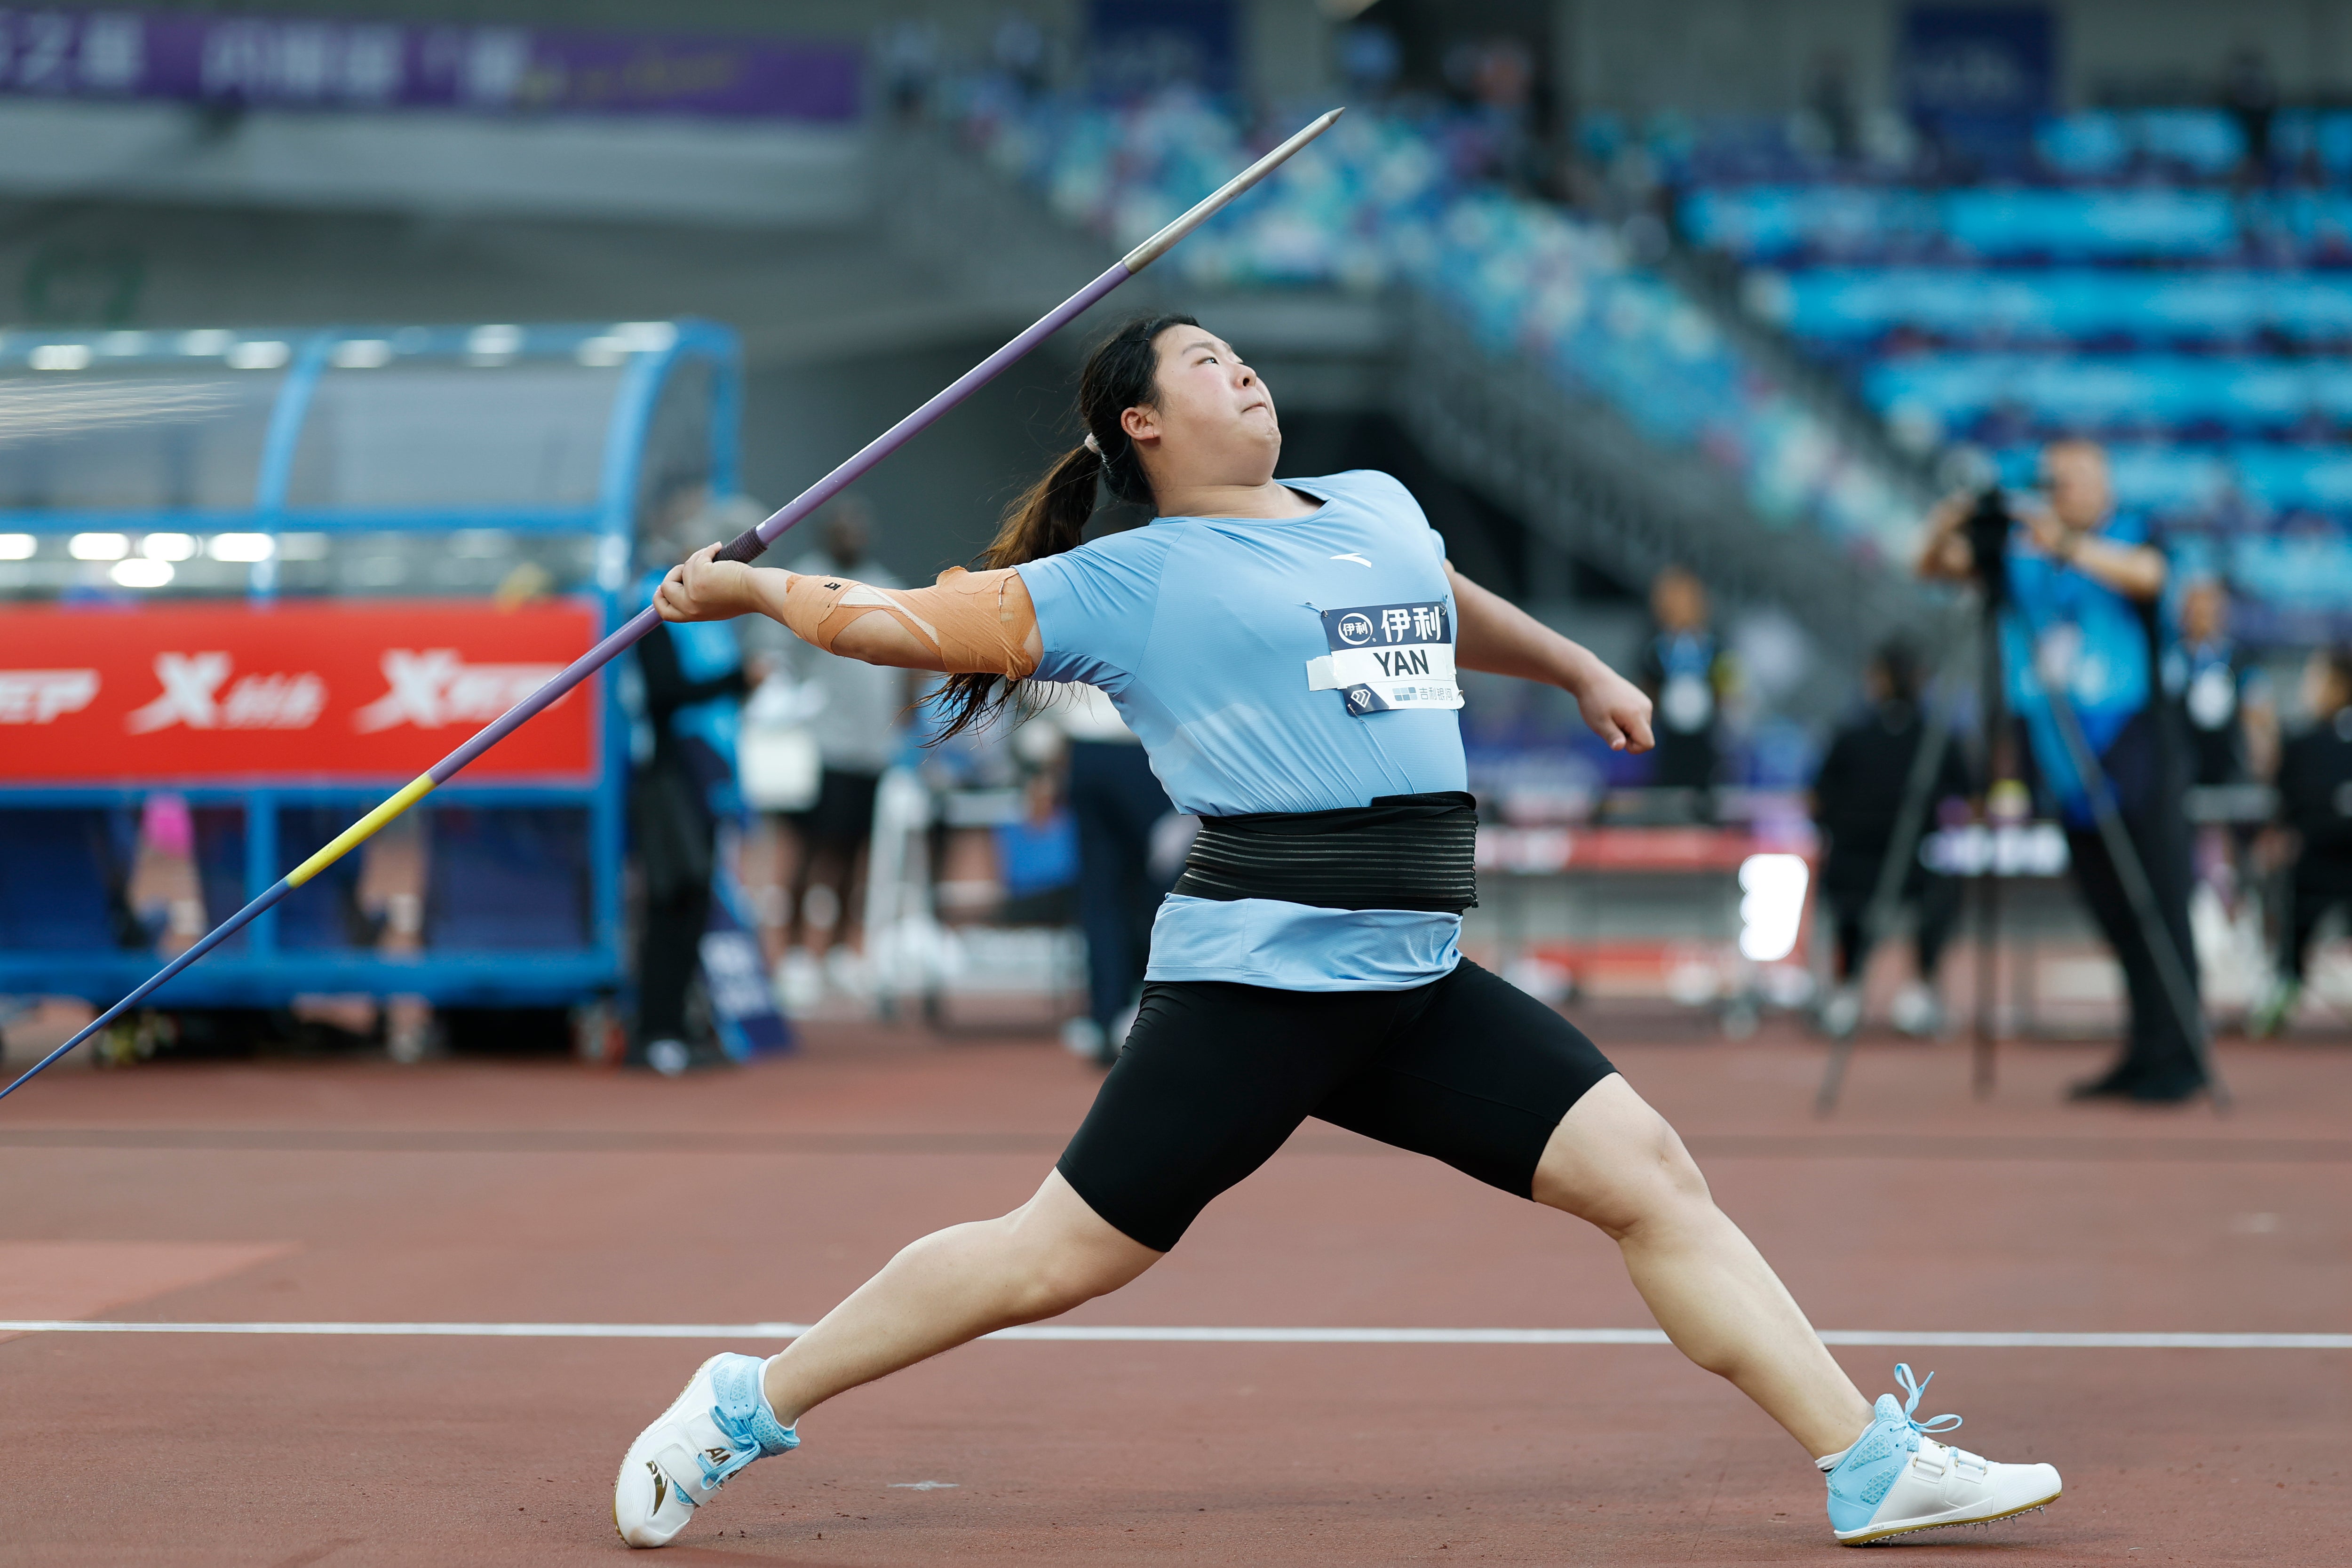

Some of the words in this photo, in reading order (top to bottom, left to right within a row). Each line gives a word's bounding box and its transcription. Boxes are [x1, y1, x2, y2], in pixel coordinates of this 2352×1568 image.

[1343, 621, 1368, 636] 伊利
[1381, 606, 1441, 643] 伊利
[1373, 650, 1430, 677] YAN
[1419, 687, 1453, 700] 吉利银河
